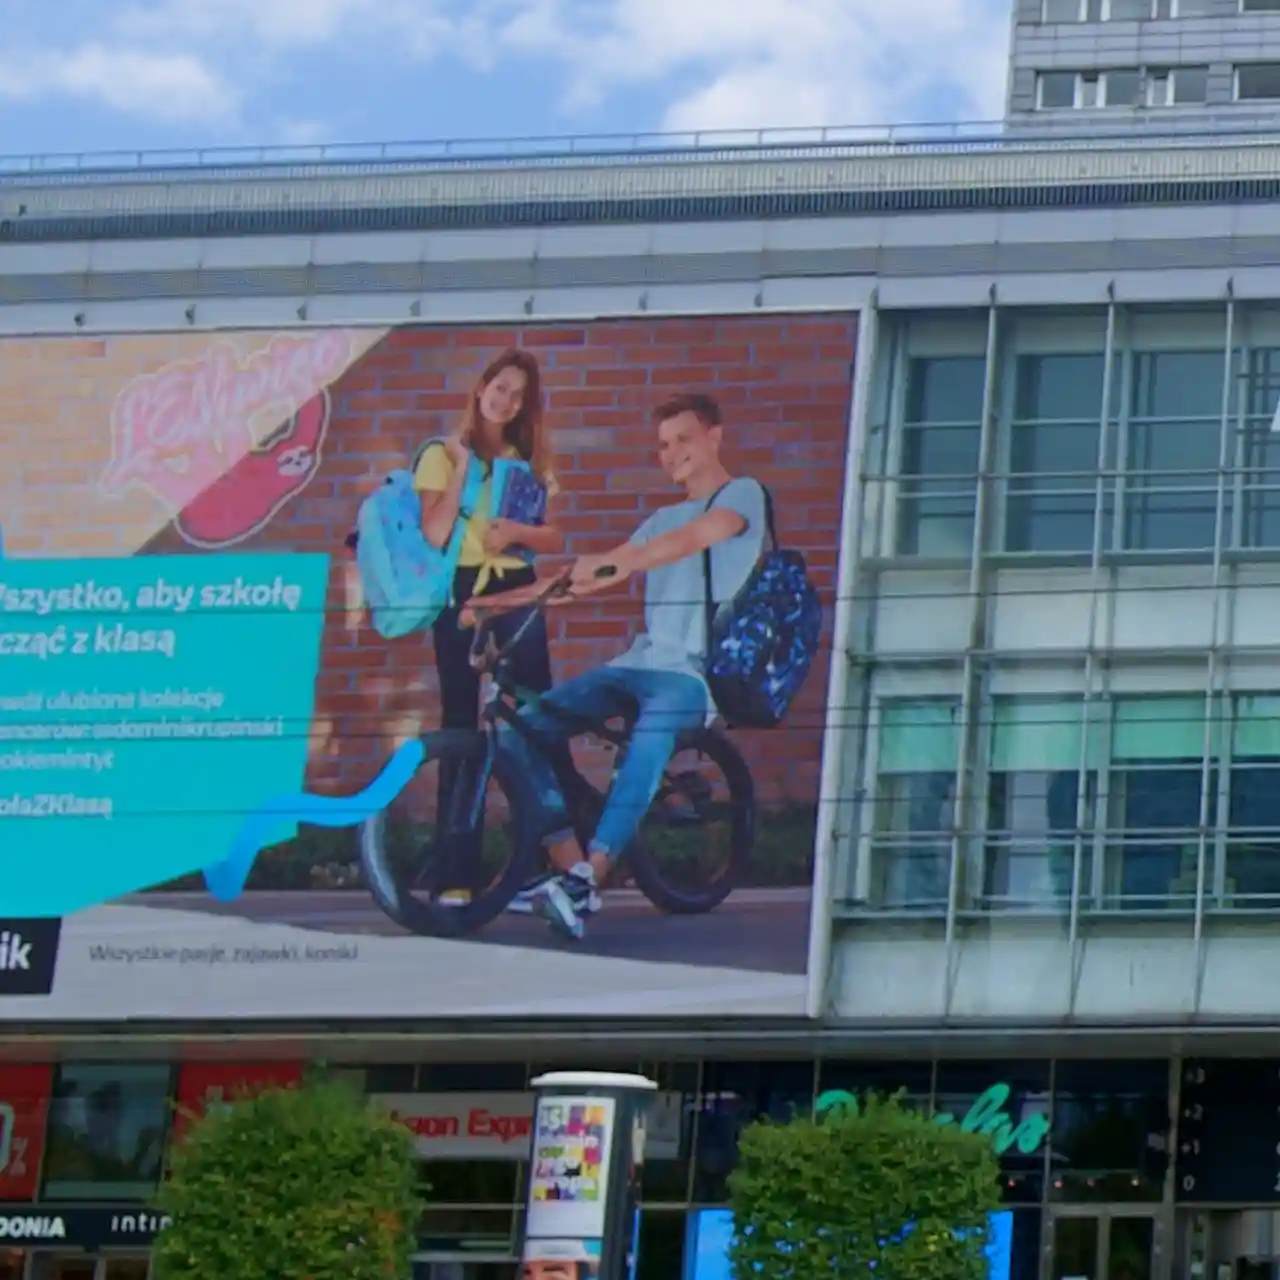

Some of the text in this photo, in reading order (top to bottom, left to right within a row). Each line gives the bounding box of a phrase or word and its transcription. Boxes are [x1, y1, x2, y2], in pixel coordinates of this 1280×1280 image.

[0, 576, 302, 615] szystko, aby szkołę
[72, 632, 89, 654] z
[94, 622, 176, 658] klasą
